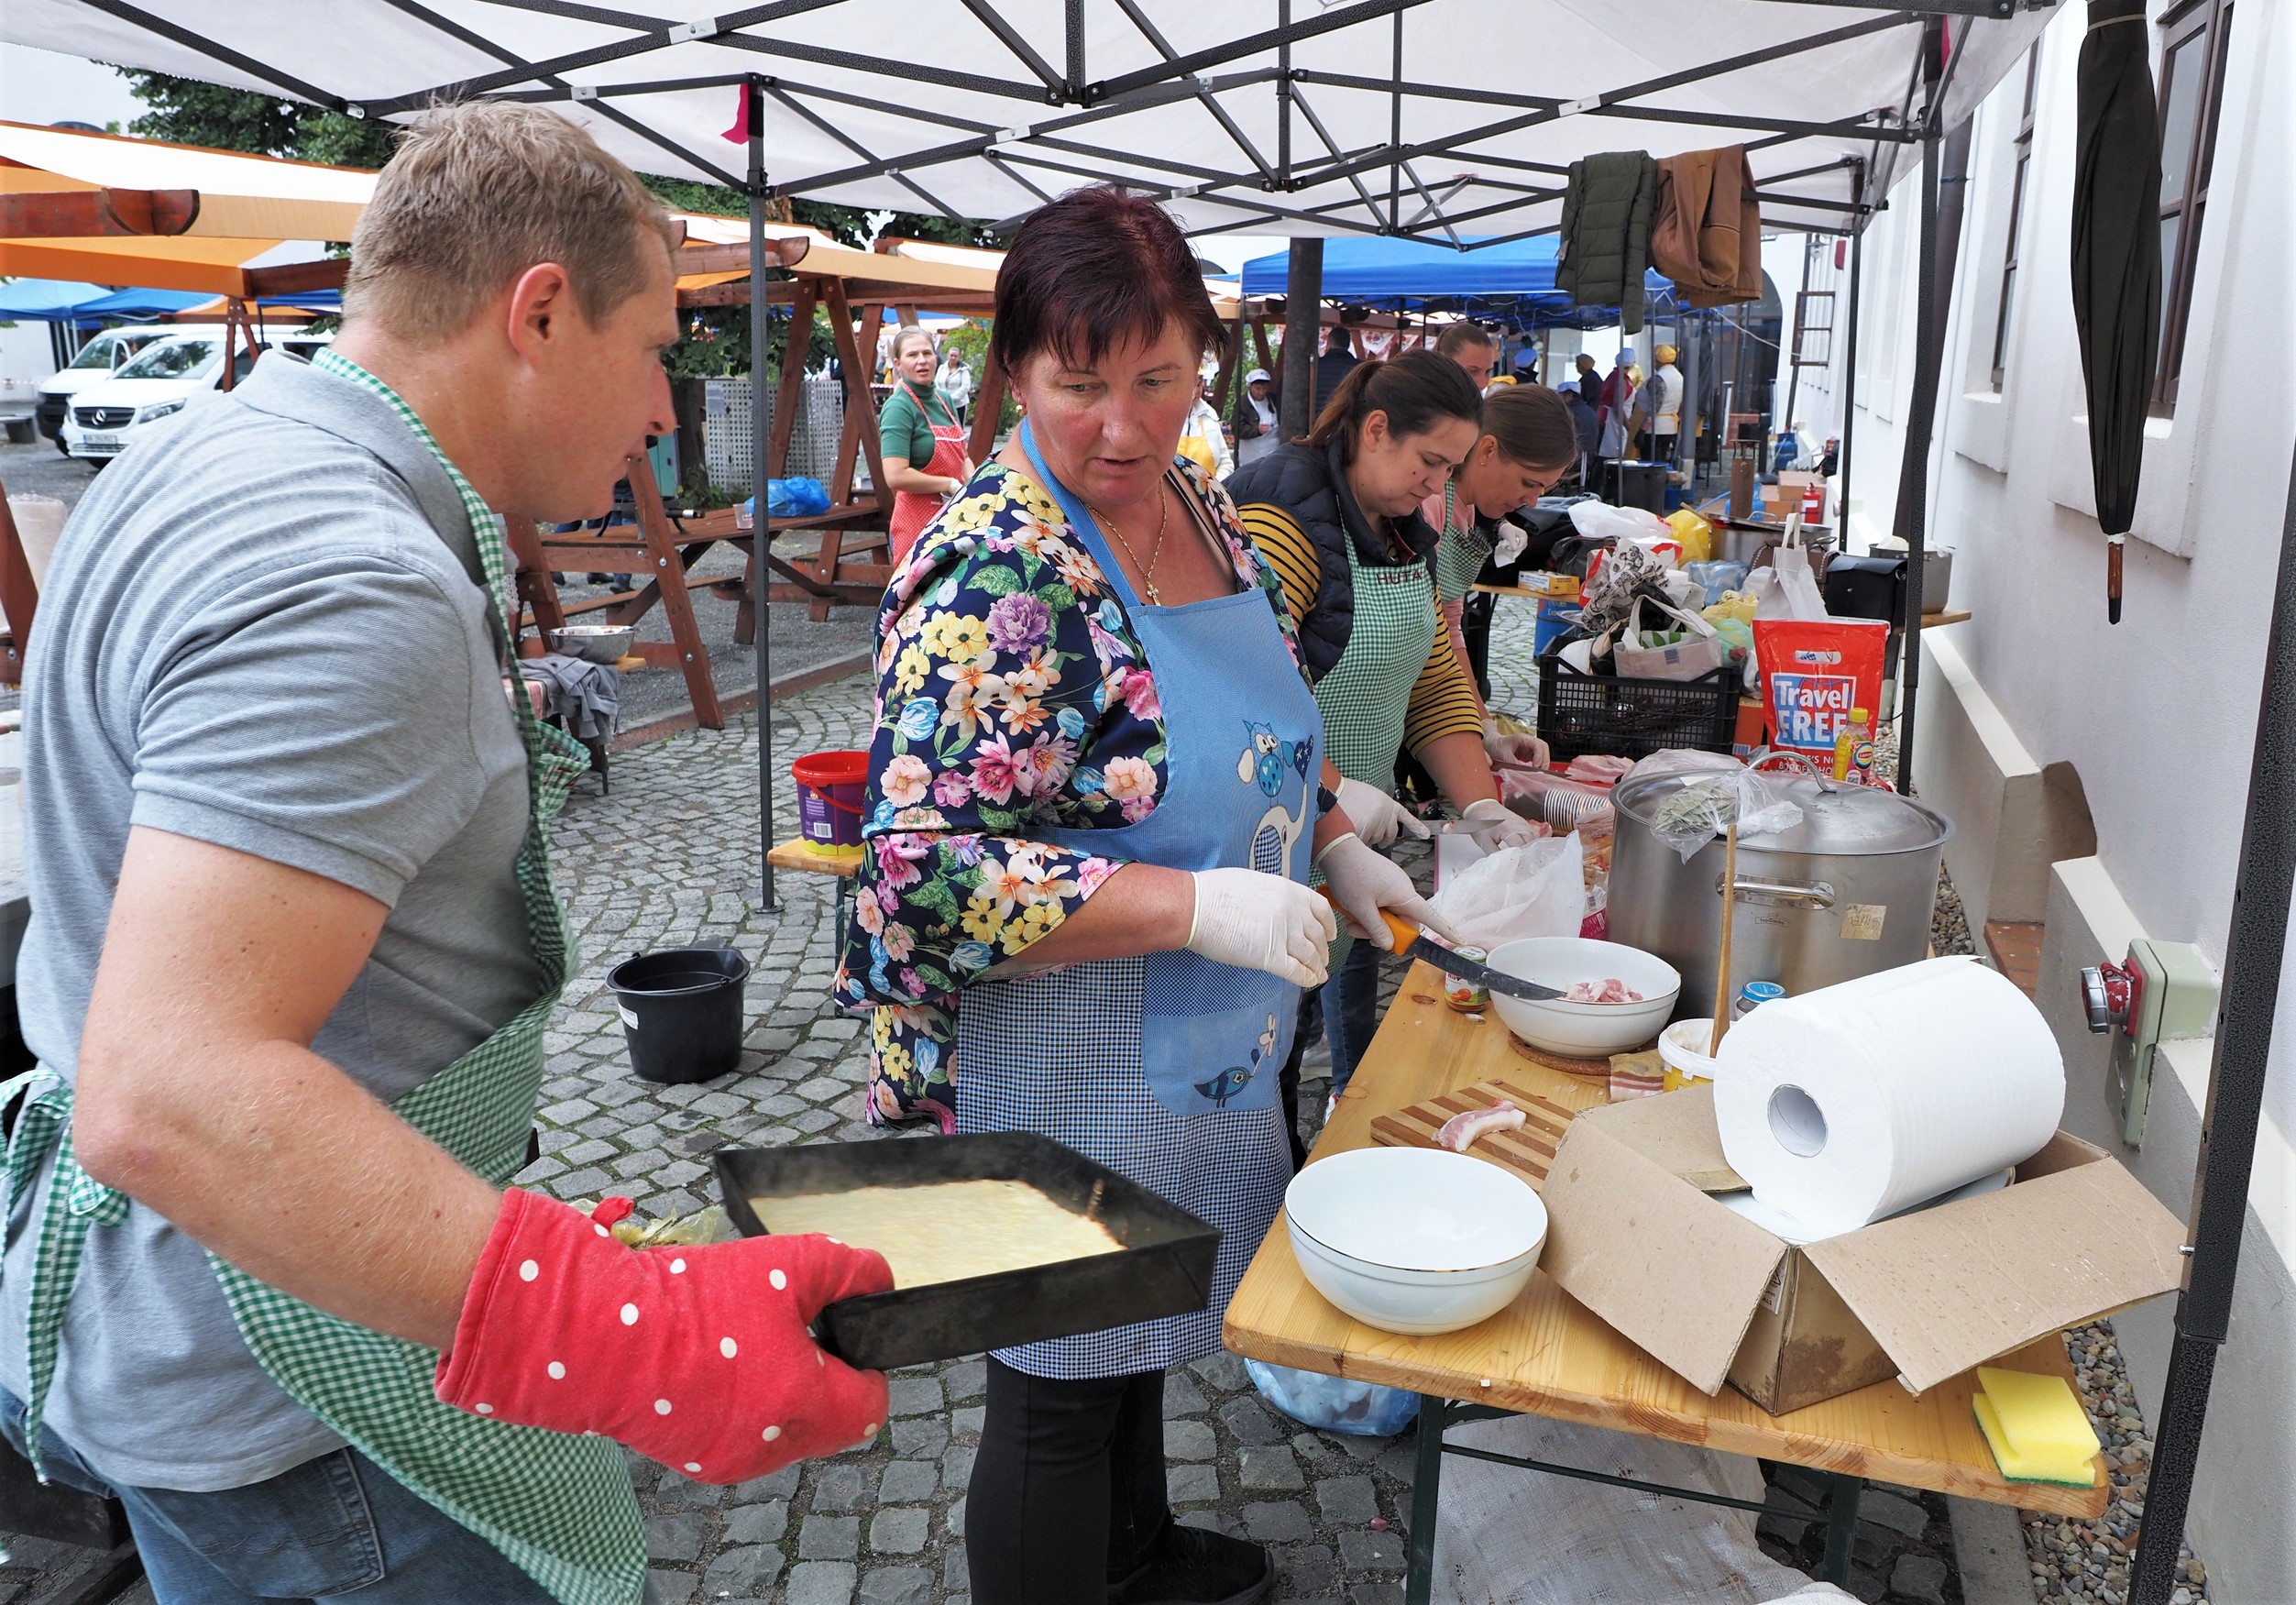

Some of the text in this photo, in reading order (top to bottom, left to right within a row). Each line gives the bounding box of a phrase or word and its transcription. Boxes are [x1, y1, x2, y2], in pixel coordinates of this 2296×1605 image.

[1376, 569, 1423, 586] HUTA
[1774, 680, 1850, 709] Travel
[1778, 709, 1848, 743] FREE
